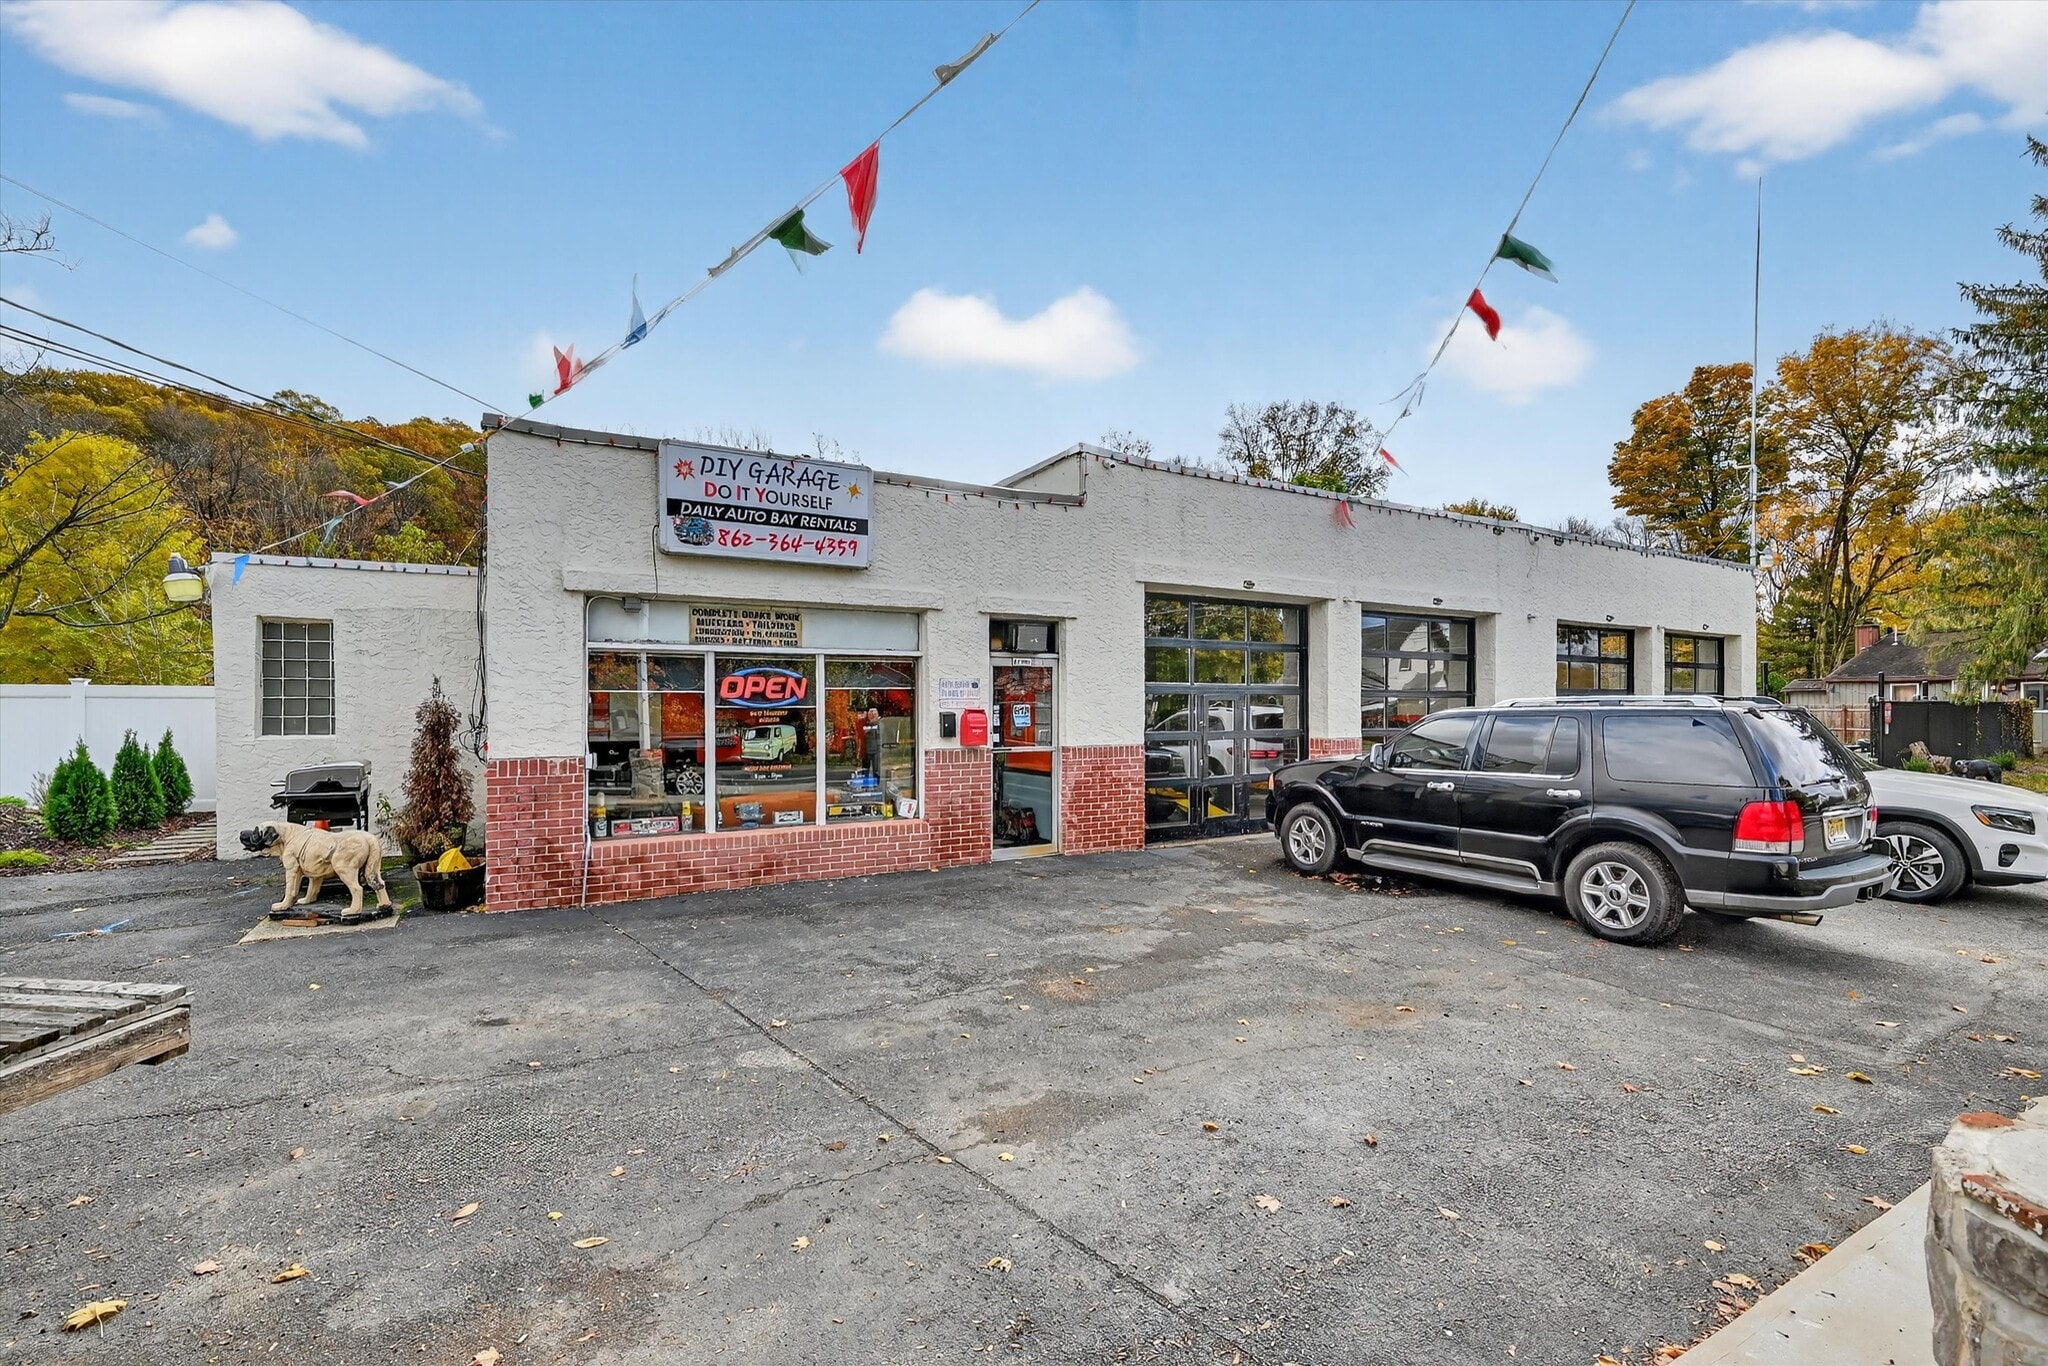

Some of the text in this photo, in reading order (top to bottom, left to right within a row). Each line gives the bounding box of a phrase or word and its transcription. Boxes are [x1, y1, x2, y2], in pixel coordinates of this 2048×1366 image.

[700, 456, 841, 491] DIY GARAGE
[704, 481, 833, 511] DO IT YOURSELF
[680, 502, 857, 532] DAILY AUTO BAY RENTALS
[718, 528, 858, 557] 862-364-4359
[720, 675, 808, 700] OPEN
